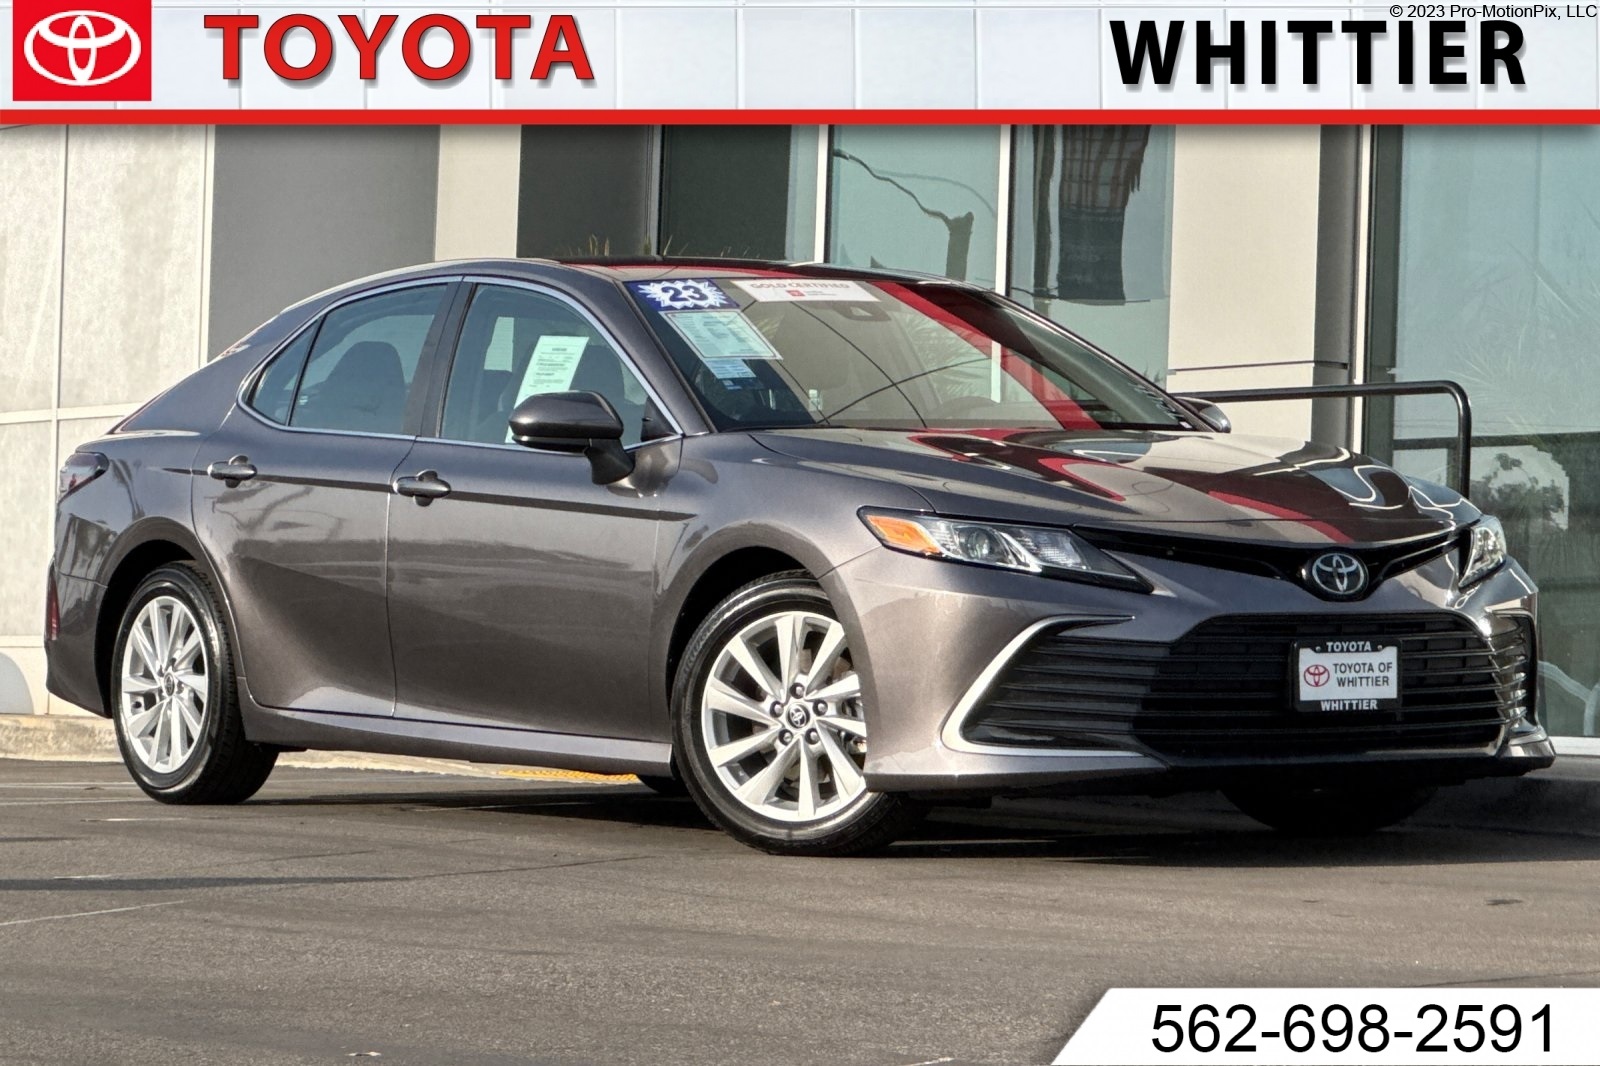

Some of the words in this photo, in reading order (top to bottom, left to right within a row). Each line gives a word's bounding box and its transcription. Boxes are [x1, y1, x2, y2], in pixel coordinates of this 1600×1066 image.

[661, 285, 709, 303] 23
[1326, 641, 1372, 652] TOYOTA
[1333, 662, 1374, 674] TOYOTA
[1378, 661, 1393, 673] OF
[1336, 676, 1390, 687] WHITTIER
[1320, 700, 1378, 711] WHITTIER
